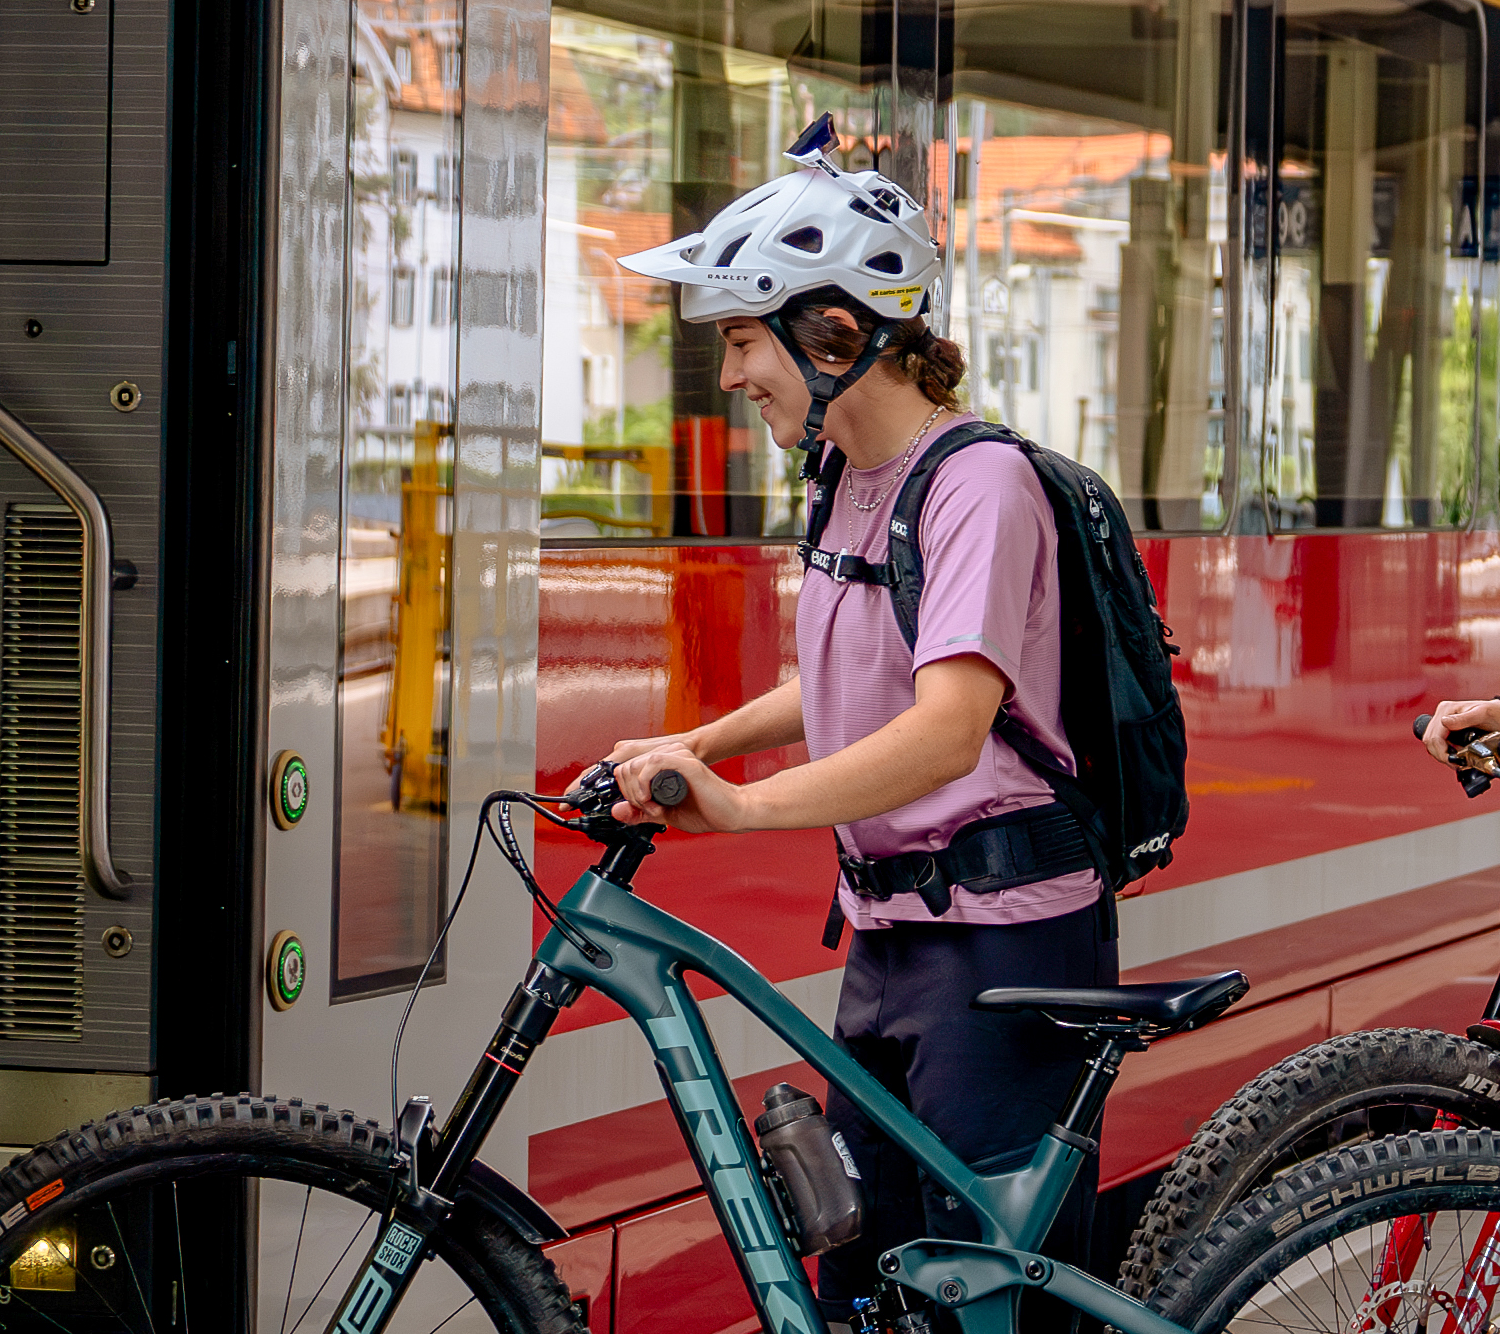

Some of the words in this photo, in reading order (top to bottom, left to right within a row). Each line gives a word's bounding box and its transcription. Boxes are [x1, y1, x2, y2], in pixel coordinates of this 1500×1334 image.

[707, 273, 749, 282] OAKLEY
[387, 1228, 417, 1253] ROCK
[379, 1245, 408, 1269] SHOX
